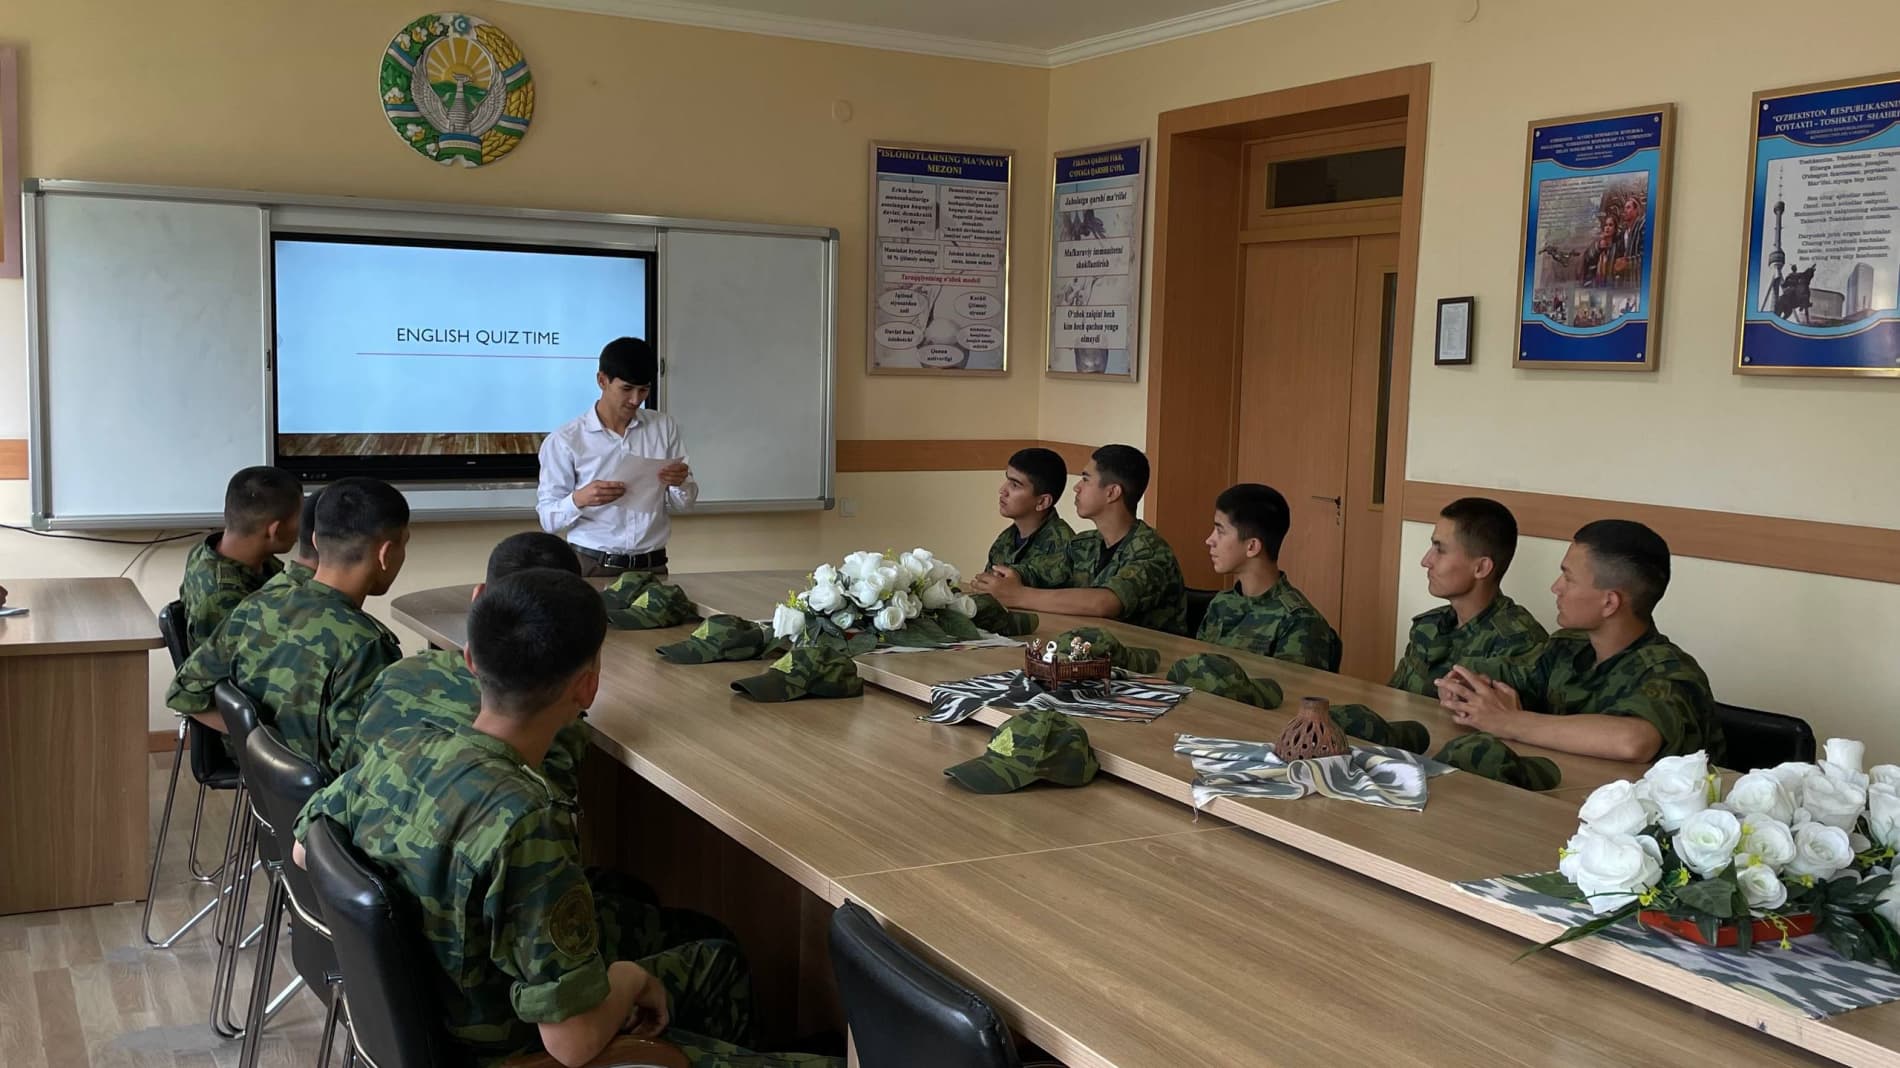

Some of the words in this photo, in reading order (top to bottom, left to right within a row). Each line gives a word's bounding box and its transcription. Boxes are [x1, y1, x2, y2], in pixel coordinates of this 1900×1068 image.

[1820, 114, 1863, 126] TOSHKENT
[928, 164, 962, 174] MEZONI
[396, 328, 470, 344] ENGLISH
[476, 329, 520, 346] QUIZ
[522, 331, 560, 345] TIME
